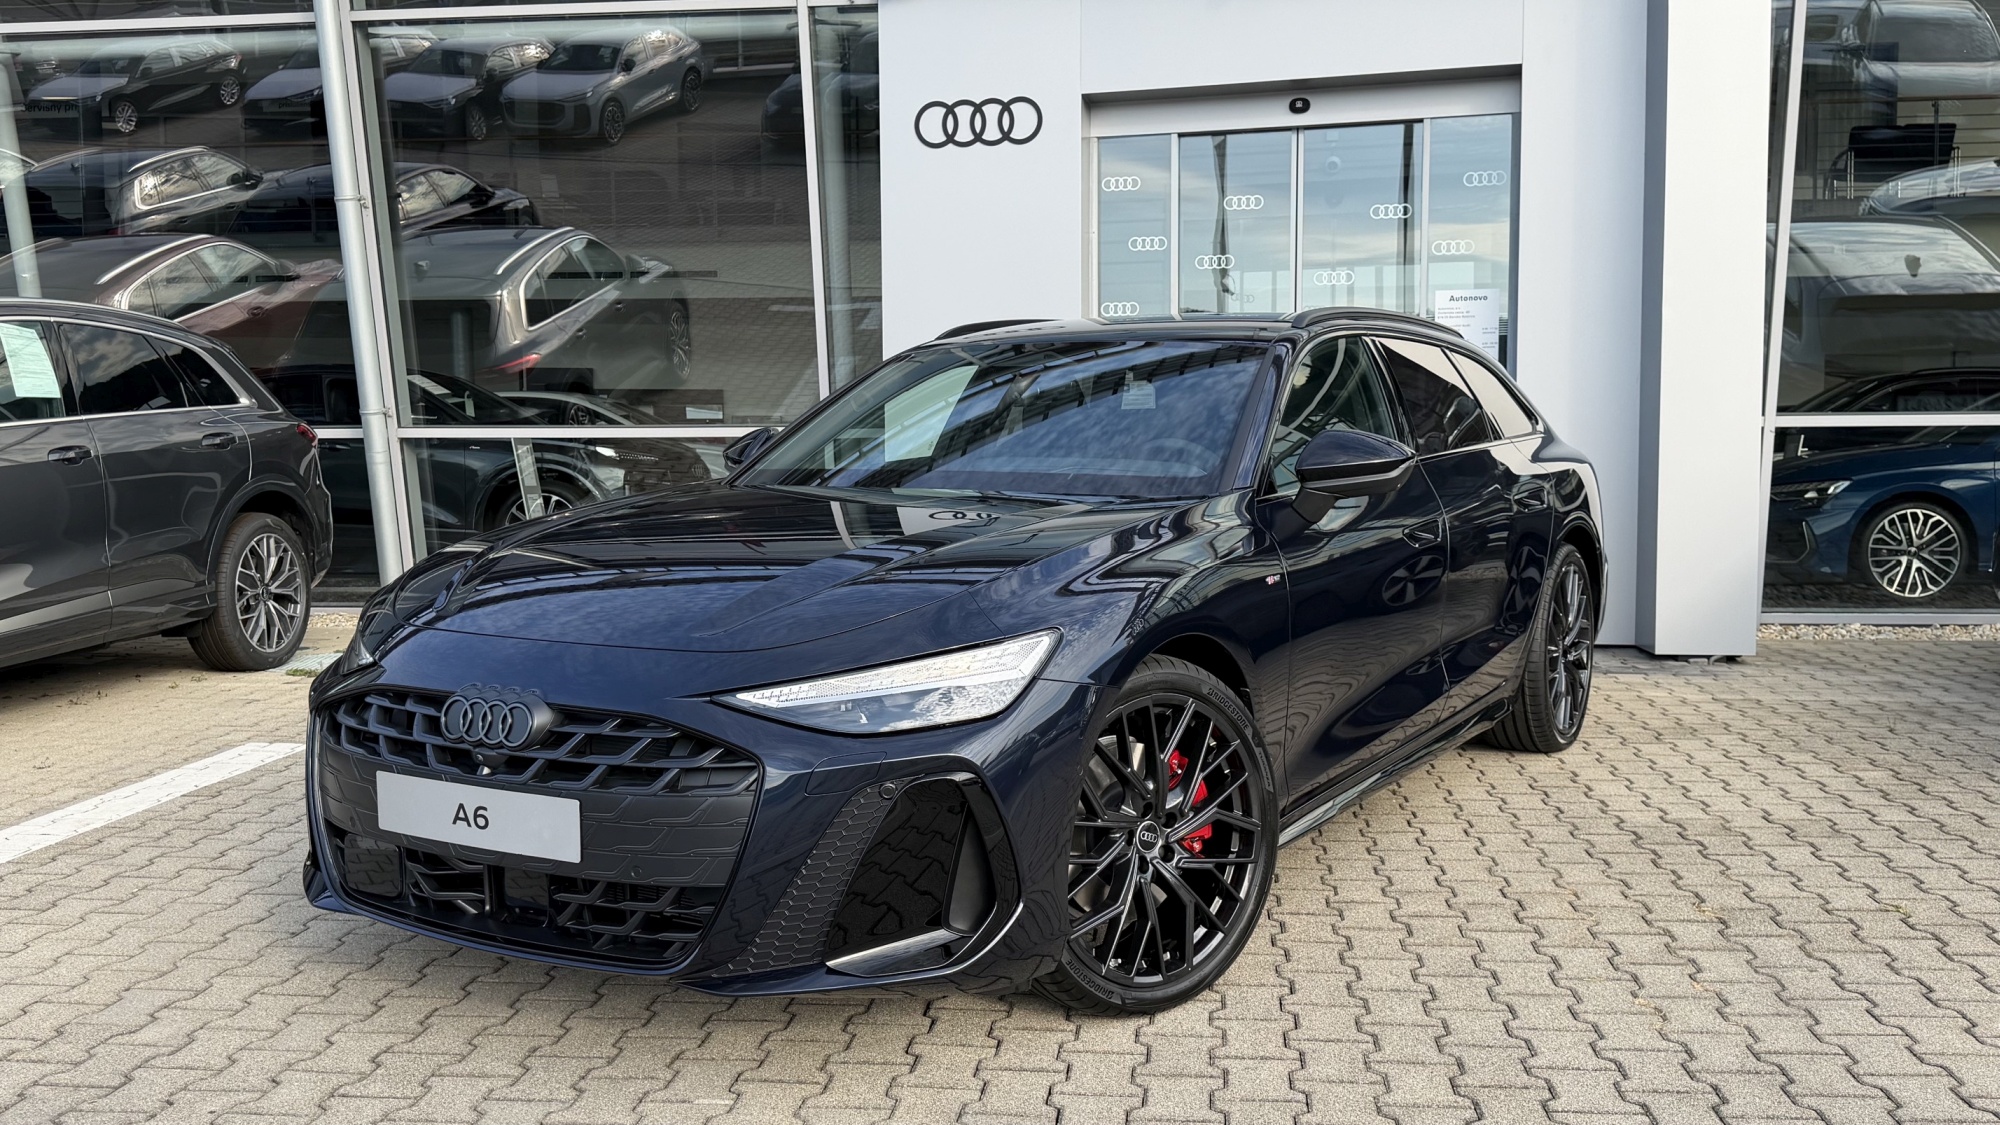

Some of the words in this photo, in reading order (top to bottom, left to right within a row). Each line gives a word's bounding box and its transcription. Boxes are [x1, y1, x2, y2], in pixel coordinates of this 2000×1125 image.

[1206, 687, 1250, 731] BRIDGESTONE
[452, 802, 490, 830] A6
[1065, 958, 1115, 999] BRIDGESTONE
